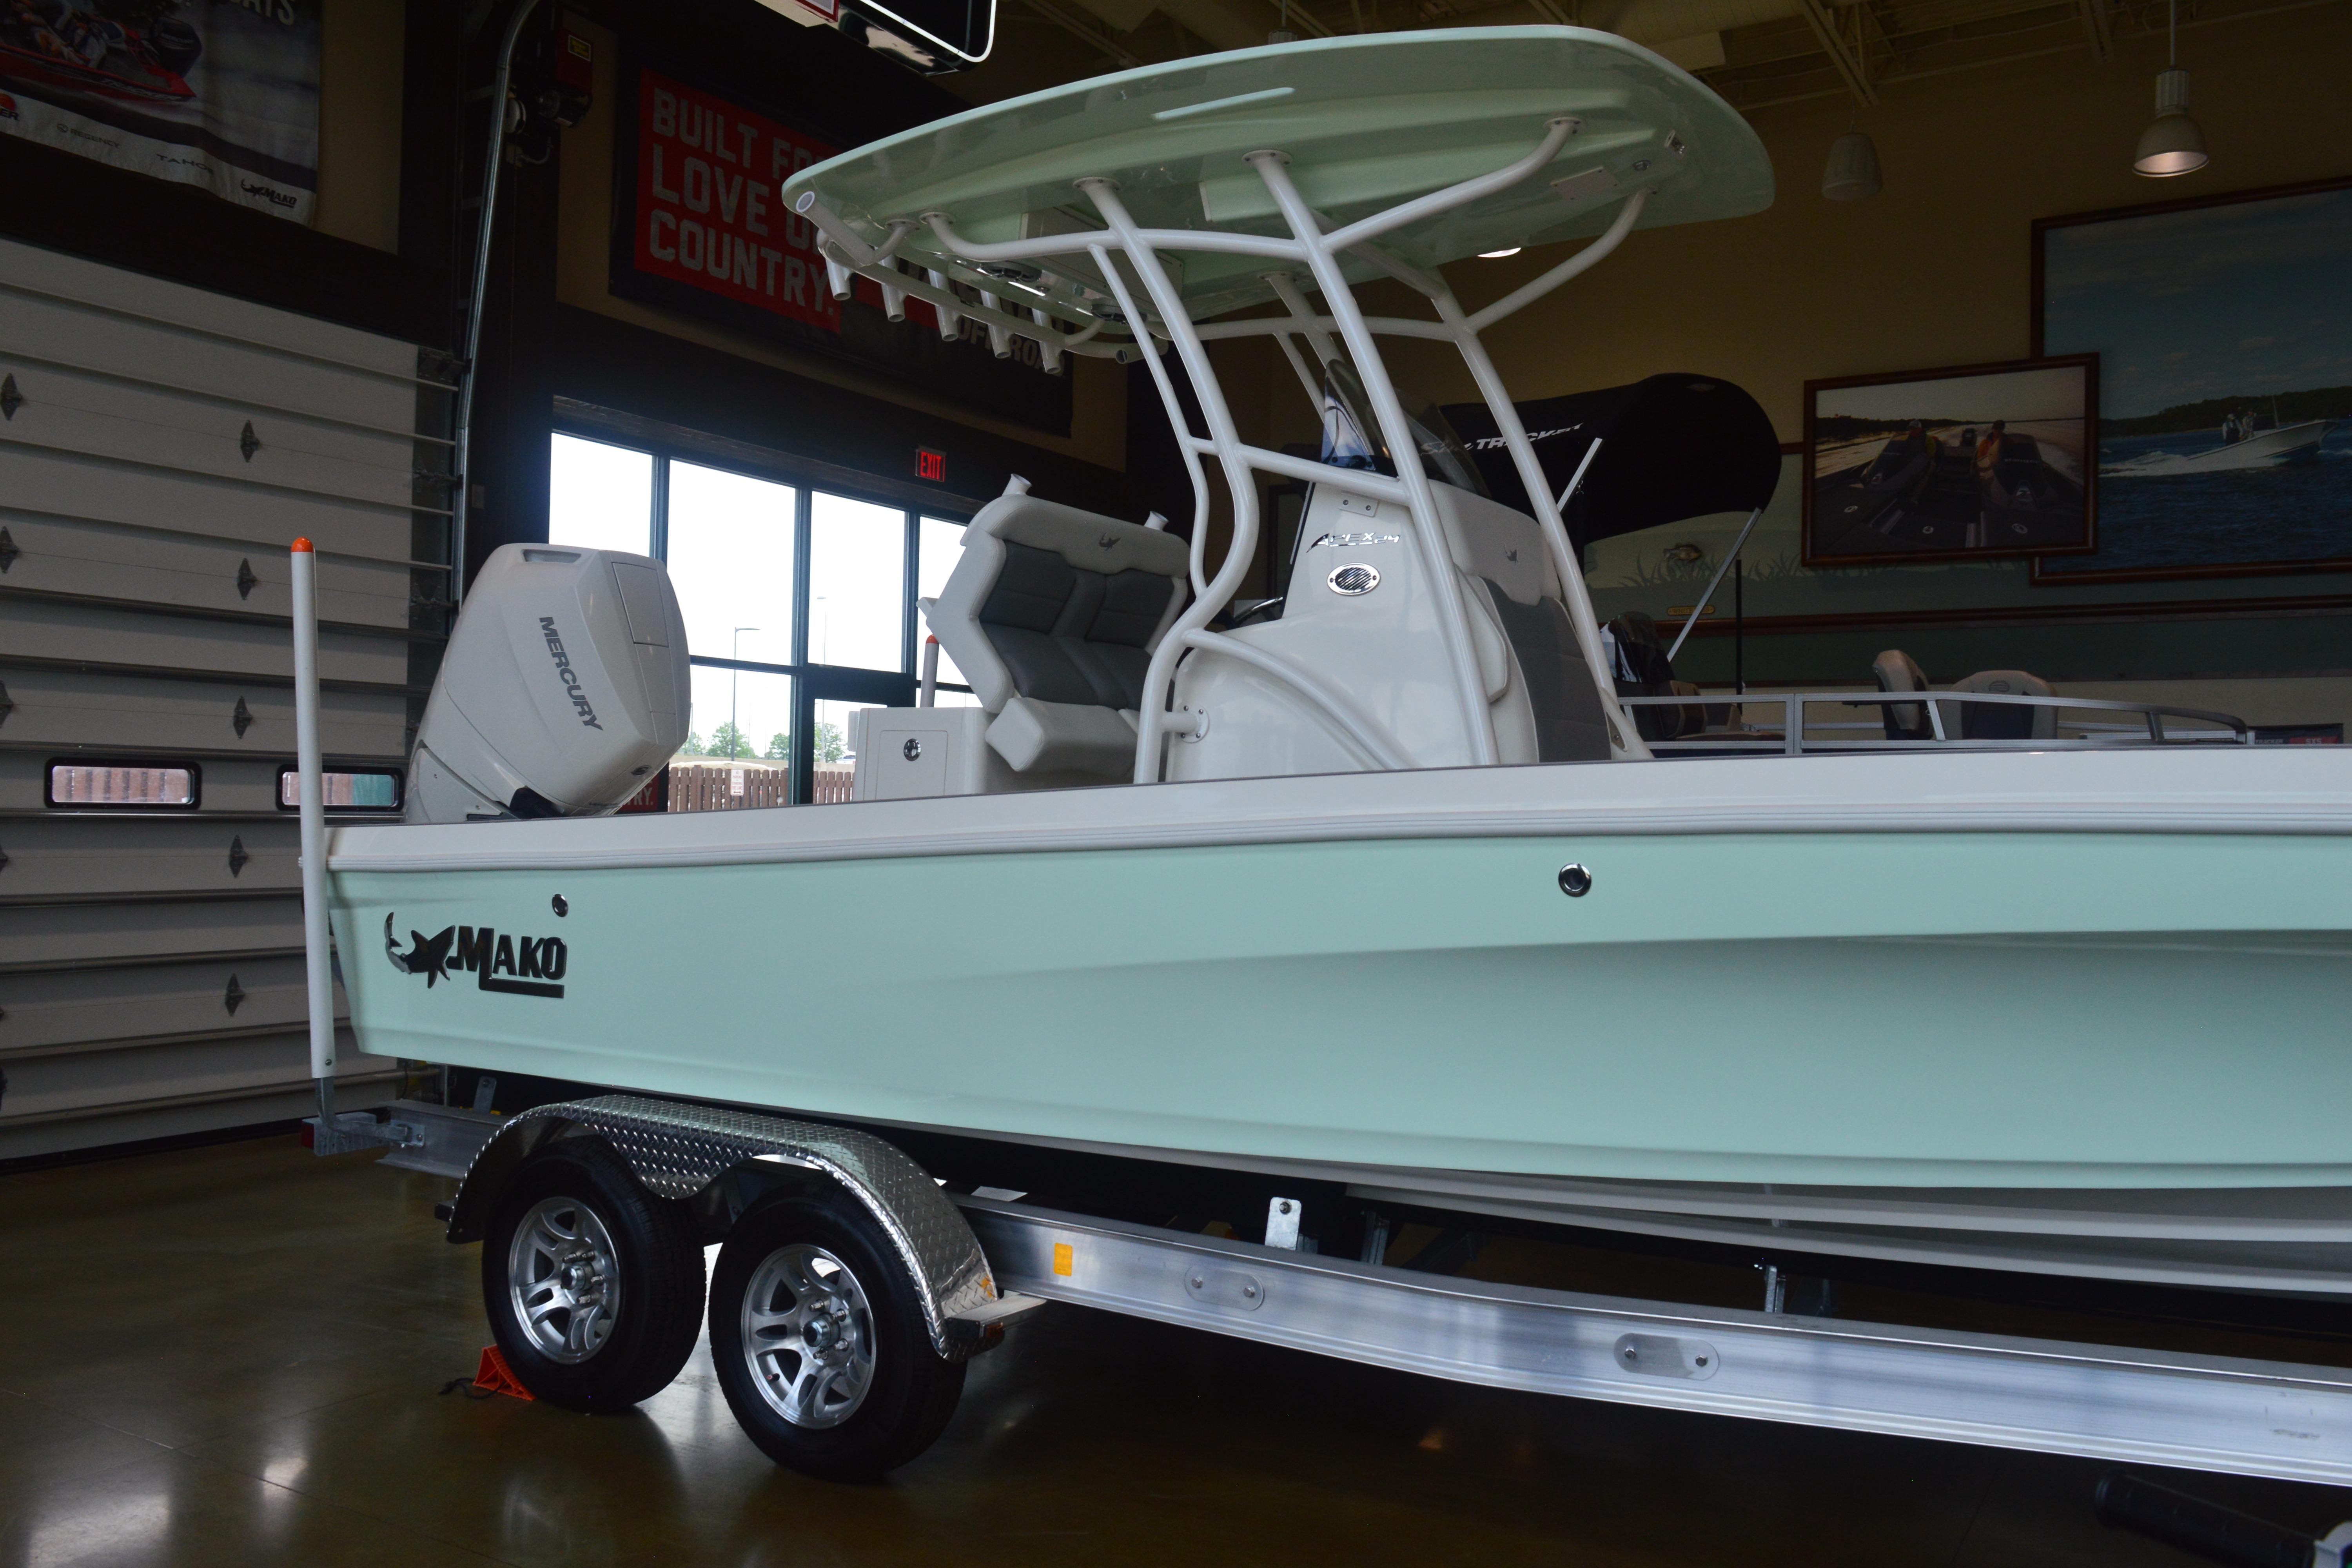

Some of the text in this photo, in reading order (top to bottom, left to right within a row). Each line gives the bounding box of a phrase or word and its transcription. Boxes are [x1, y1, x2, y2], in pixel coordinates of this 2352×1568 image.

[71, 128, 119, 148] REGENCY
[653, 87, 826, 180] BUILT FO
[261, 187, 297, 208] MAKO
[652, 143, 769, 236] LOVE
[650, 208, 834, 316] COUNTRY.
[920, 451, 942, 480] EXIT
[539, 616, 604, 731] MERCURY
[446, 925, 568, 999] MAKO
